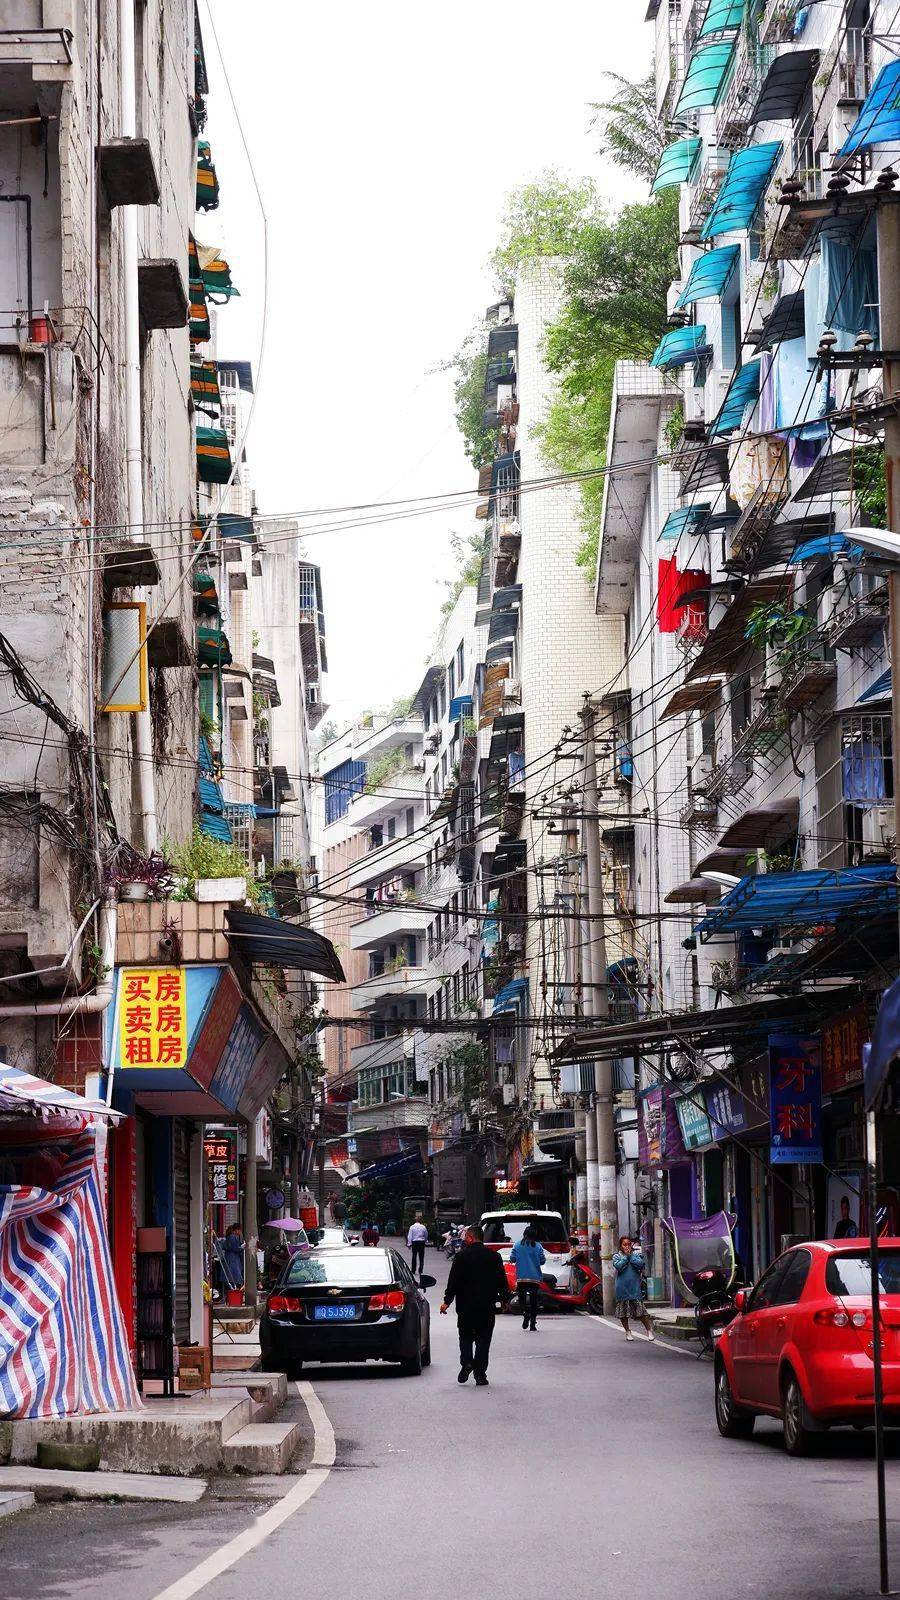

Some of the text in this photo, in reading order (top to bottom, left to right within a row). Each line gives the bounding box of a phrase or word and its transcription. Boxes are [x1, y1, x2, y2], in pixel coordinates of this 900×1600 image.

[124, 973, 182, 1002] 买房
[124, 1004, 182, 1034] 卖房
[125, 1035, 183, 1064] 租房
[776, 1058, 817, 1139] 牙科
